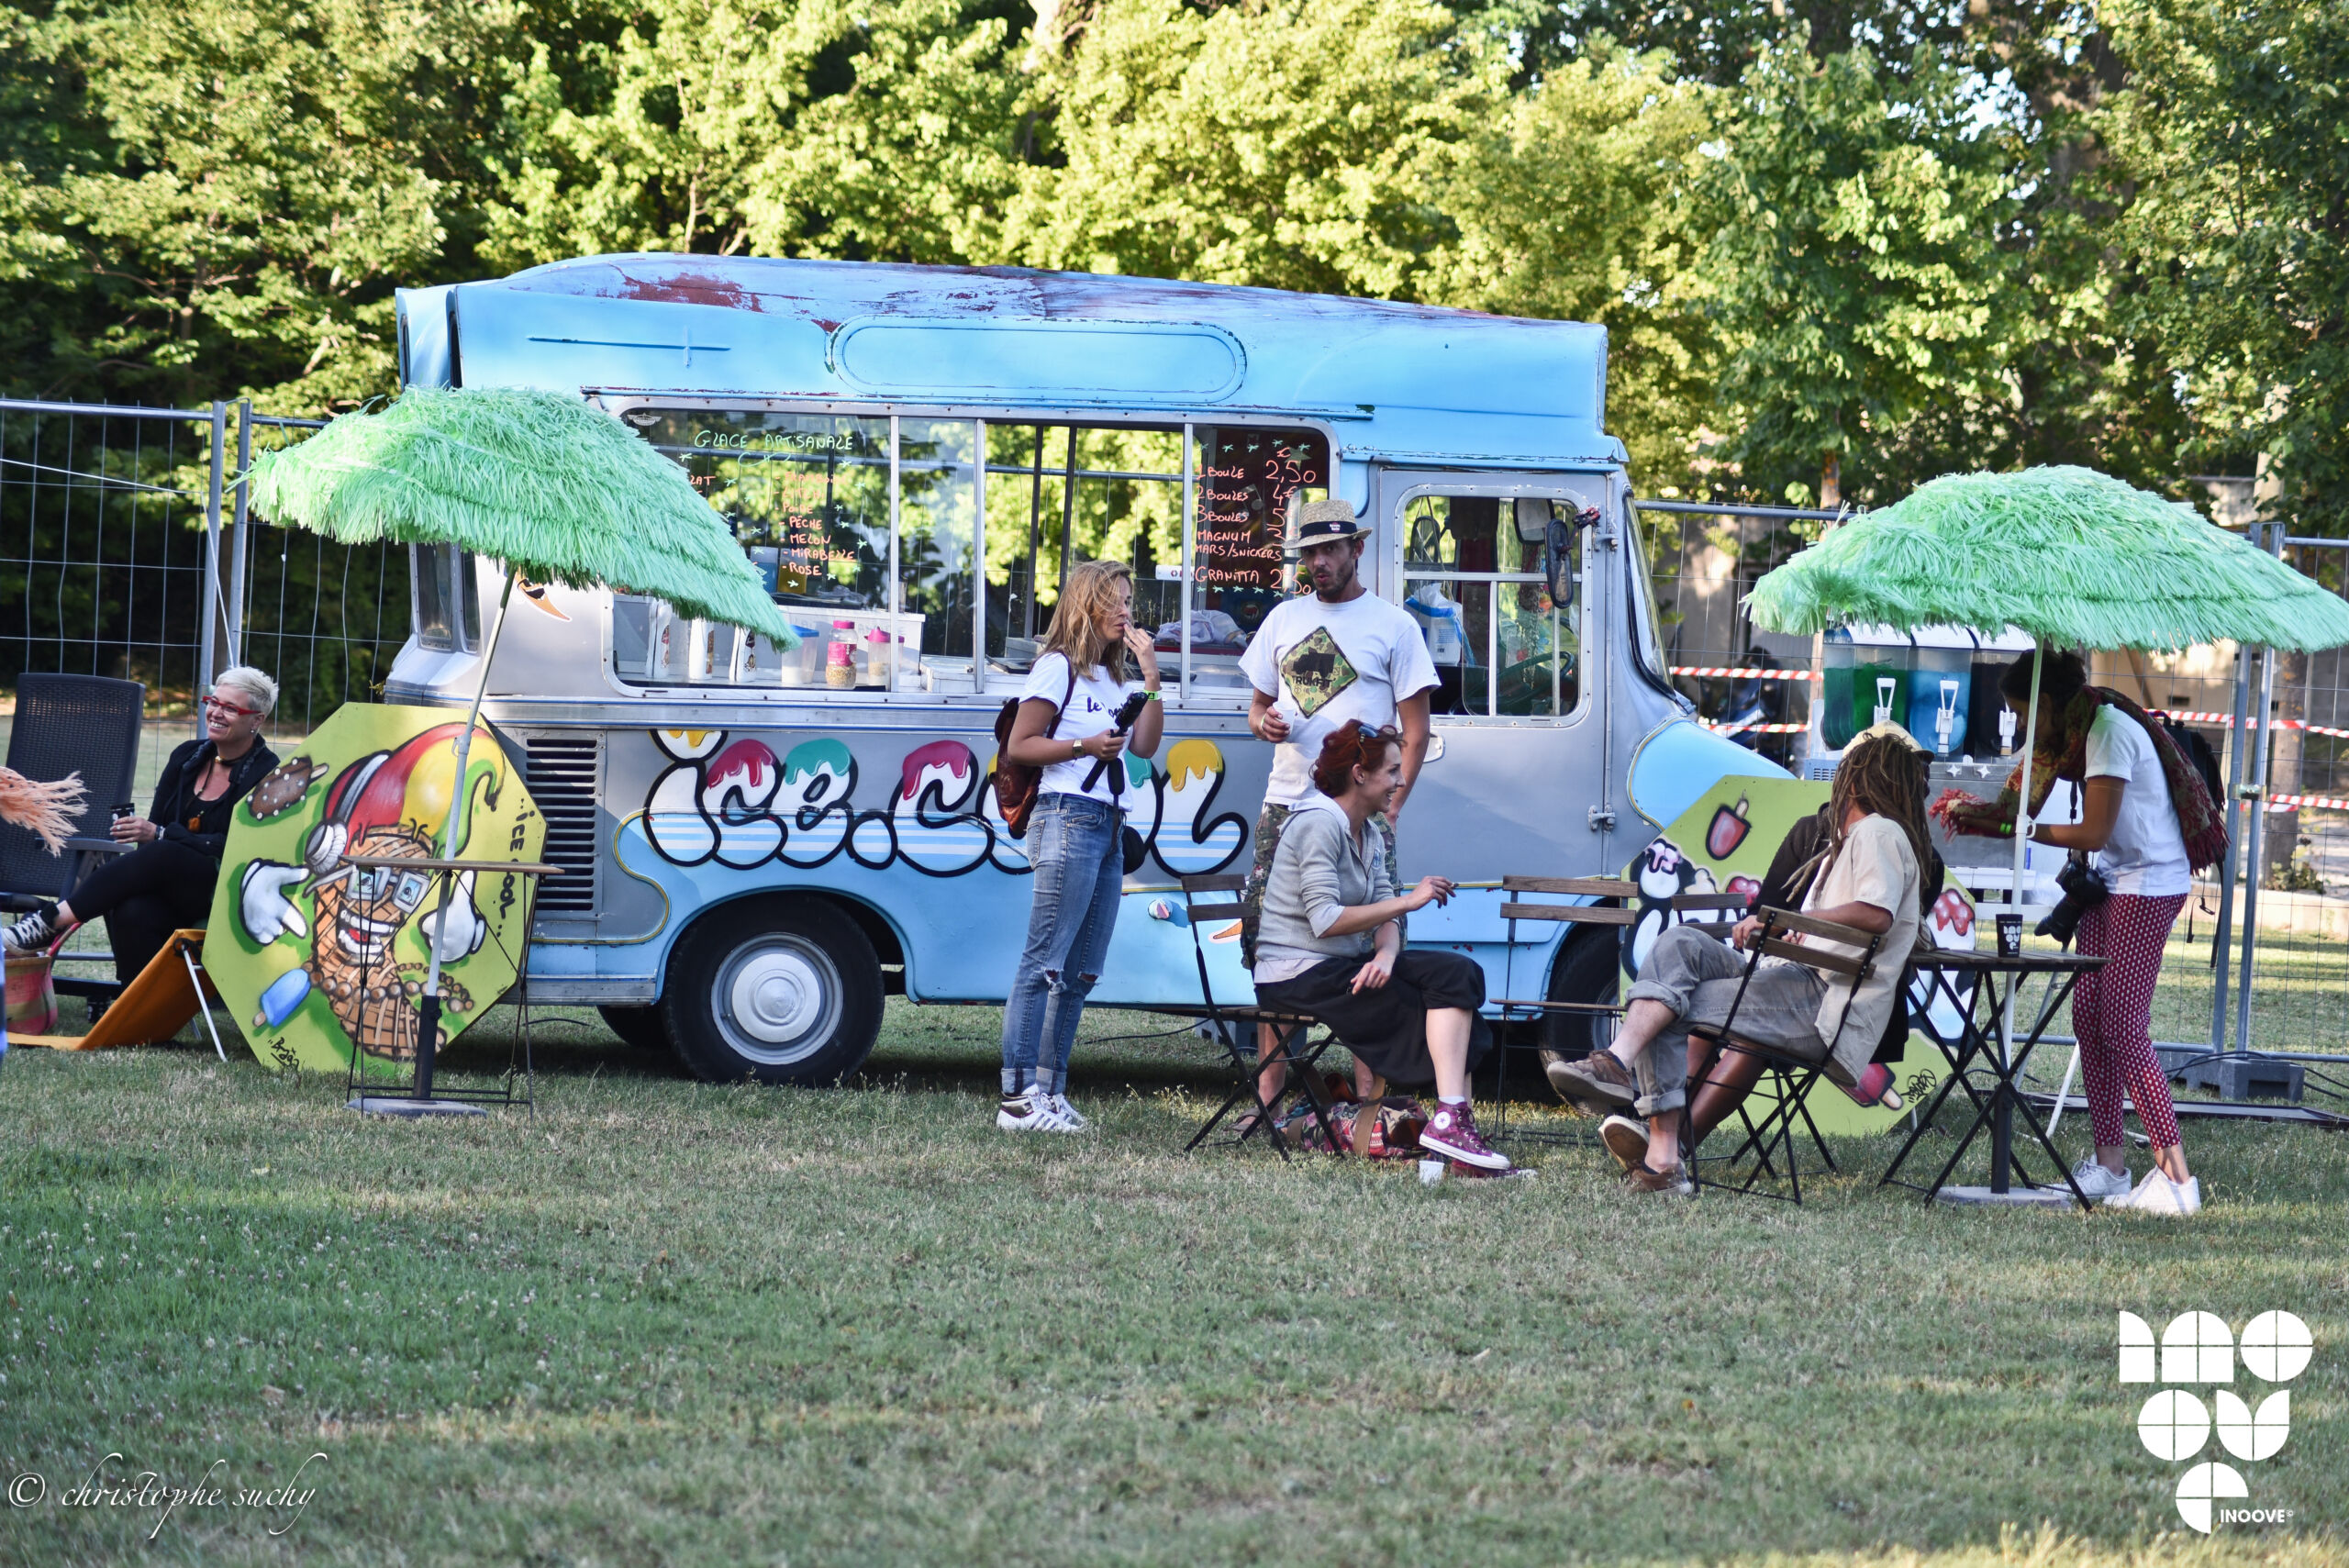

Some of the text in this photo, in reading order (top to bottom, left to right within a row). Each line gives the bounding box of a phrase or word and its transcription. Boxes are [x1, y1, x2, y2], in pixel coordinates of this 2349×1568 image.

[694, 429, 748, 449] GLACE
[1208, 465, 1244, 479] BOULE
[1265, 460, 1316, 484] 2,50
[1207, 489, 1249, 501] BOULES
[1208, 510, 1249, 523] BOULES
[790, 534, 831, 545] MELON
[1197, 529, 1252, 543] MAGNUM
[789, 562, 822, 576] ROSE
